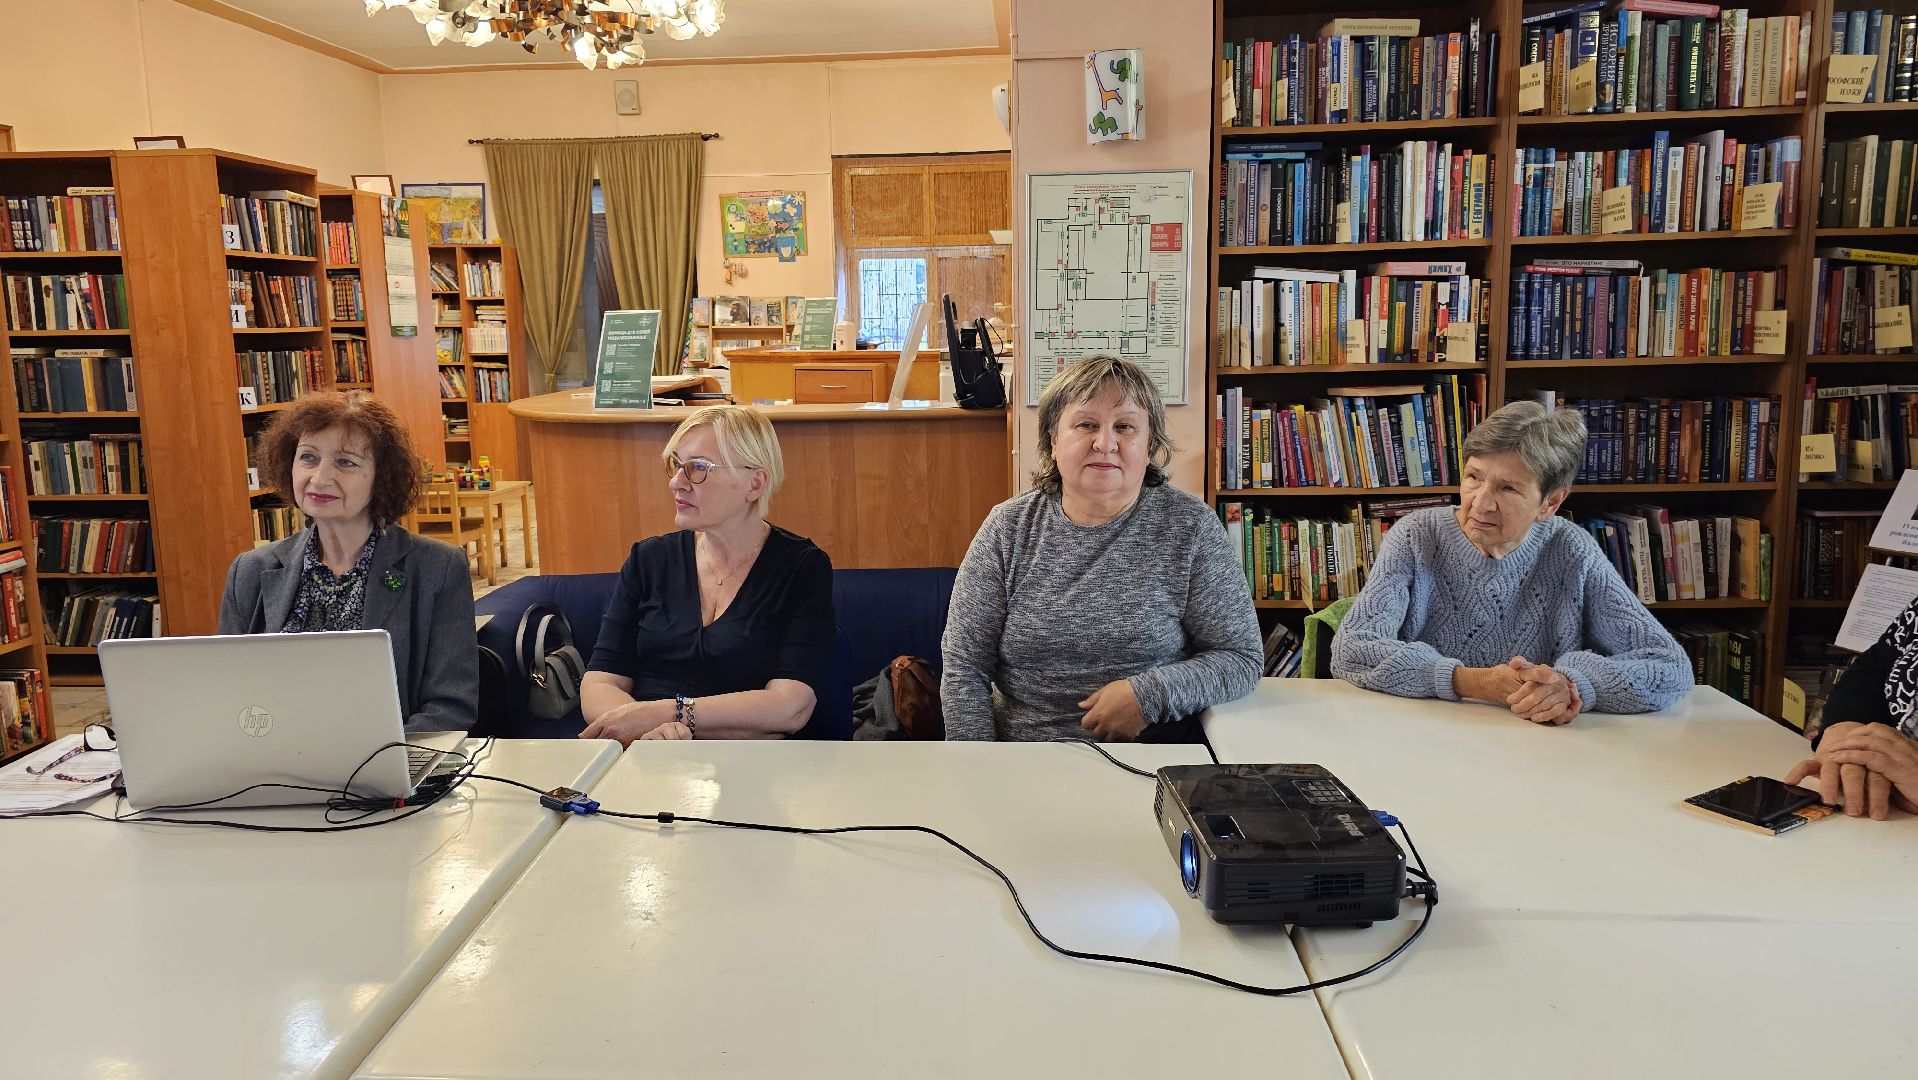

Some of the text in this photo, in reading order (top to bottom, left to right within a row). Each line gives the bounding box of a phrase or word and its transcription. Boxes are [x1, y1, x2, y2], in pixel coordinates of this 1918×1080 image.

[1411, 47, 1420, 85] МАТЕМАТИКА
[1607, 23, 1618, 82] ИСТОРИЯ
[1573, 197, 1584, 232] ЛОНДОН
[1590, 197, 1602, 234] ВЕНЕЦИЯ
[240, 392, 253, 406] К
[1749, 432, 1757, 448] РЕЧИ
[1242, 443, 1251, 469] ЧУДЕСА
[1747, 448, 1758, 479] КУЛЬТУРА
[1326, 544, 1335, 574] ОГОРОД
